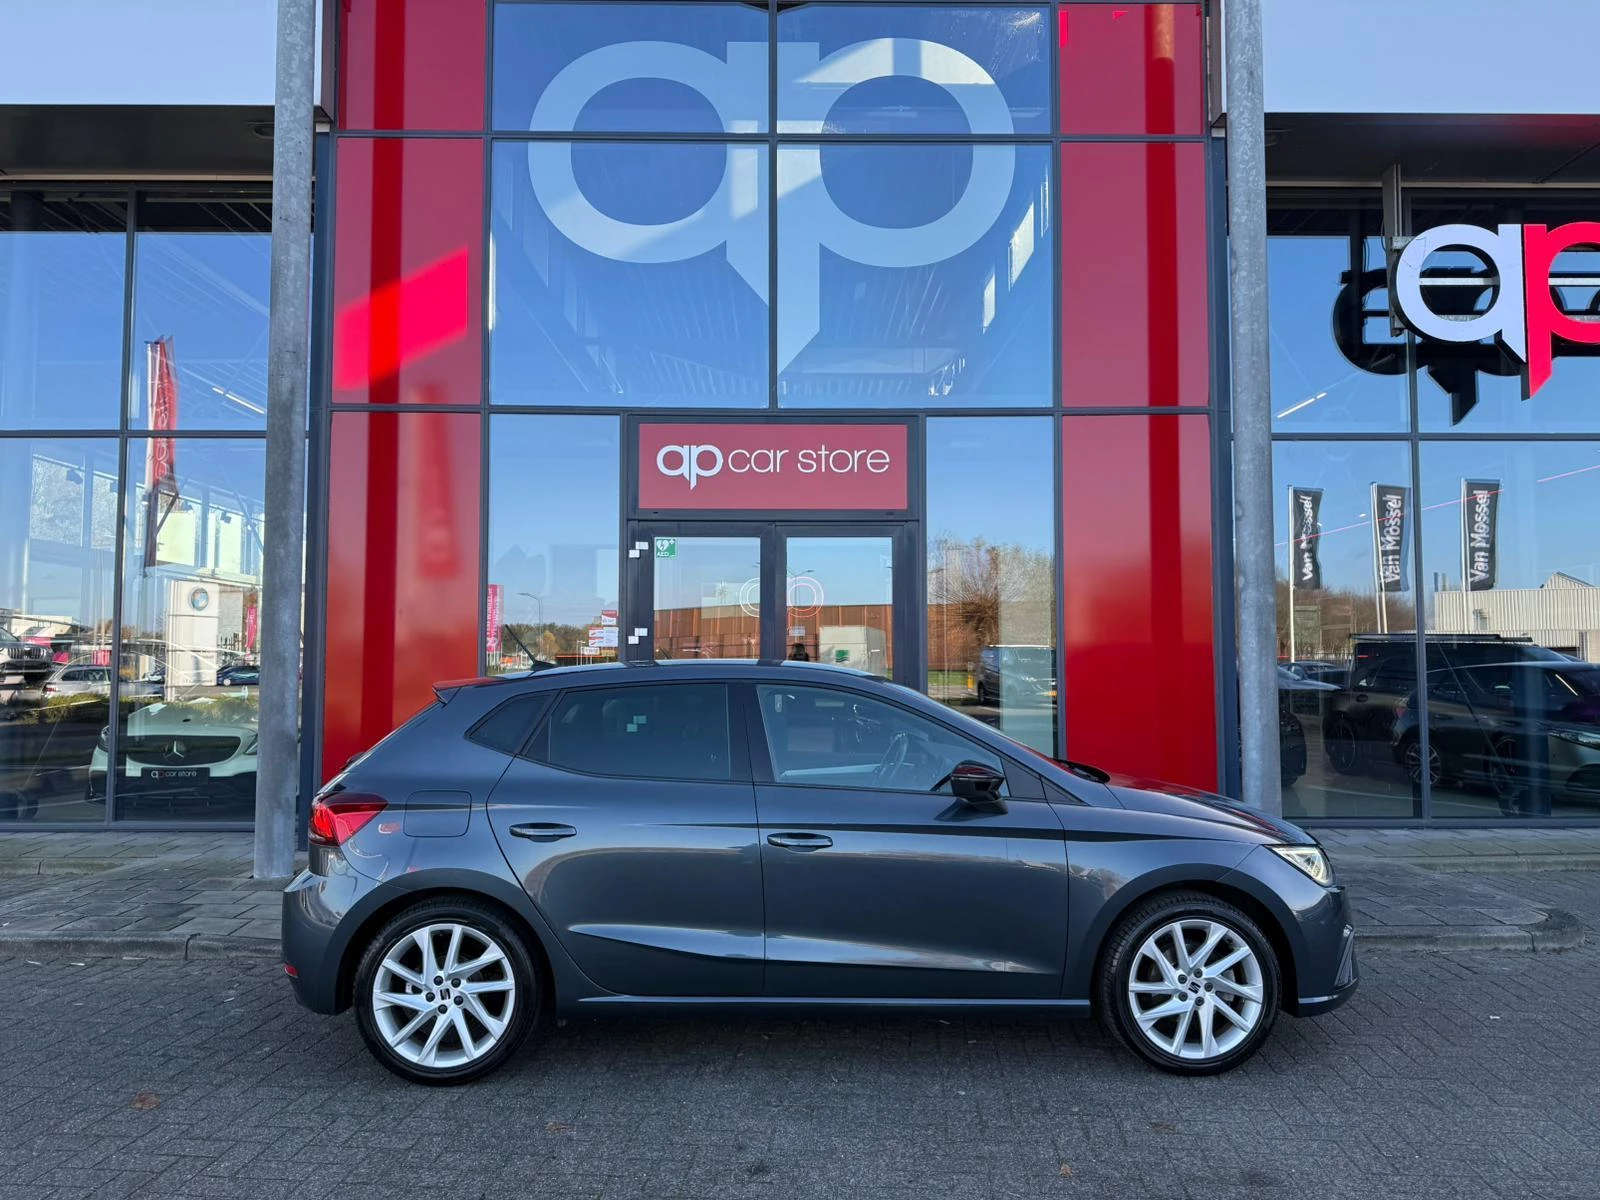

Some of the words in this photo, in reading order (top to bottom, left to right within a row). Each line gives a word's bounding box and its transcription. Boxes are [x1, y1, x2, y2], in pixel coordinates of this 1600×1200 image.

[528, 38, 1015, 373] ap
[1396, 222, 1600, 399] ap
[656, 444, 724, 490] ap
[728, 449, 789, 473] car
[797, 444, 890, 473] store
[1381, 494, 1402, 550] Mossel
[1470, 490, 1490, 548] Mossel
[1302, 552, 1314, 581] Van
[1381, 554, 1400, 582] Van
[1470, 551, 1489, 582] Van
